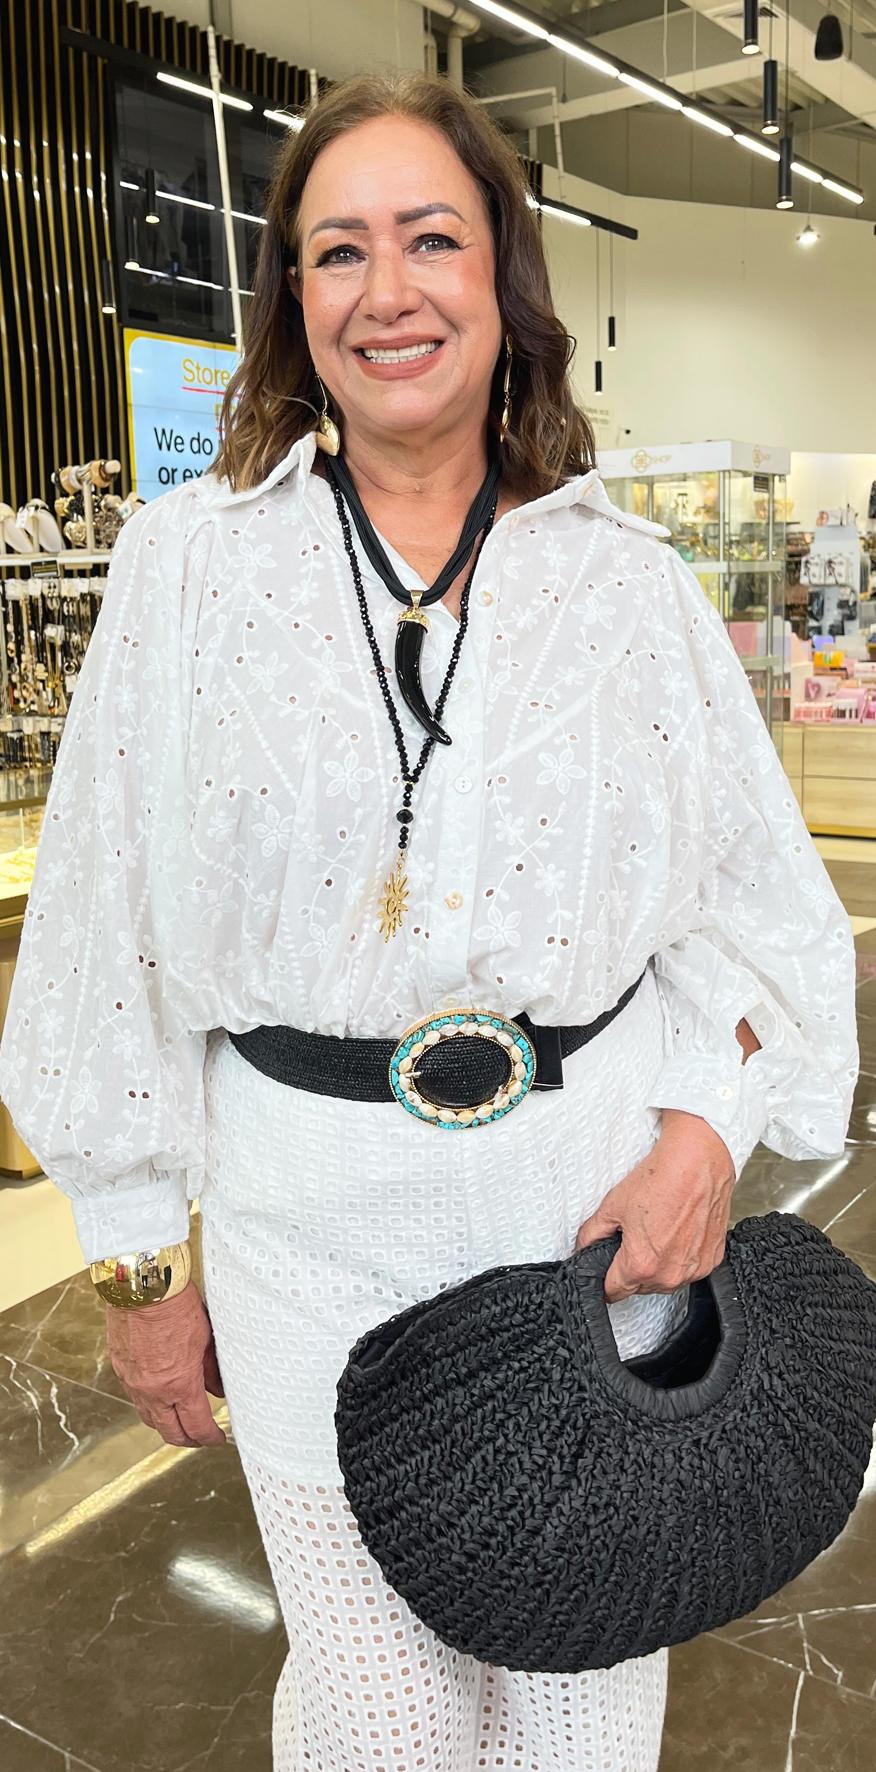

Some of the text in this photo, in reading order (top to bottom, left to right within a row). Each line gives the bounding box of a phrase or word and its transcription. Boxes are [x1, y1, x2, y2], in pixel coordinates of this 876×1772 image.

[182, 358, 231, 388] Store
[154, 427, 213, 456] We do
[650, 455, 671, 464] SHOP
[158, 466, 178, 486] or
